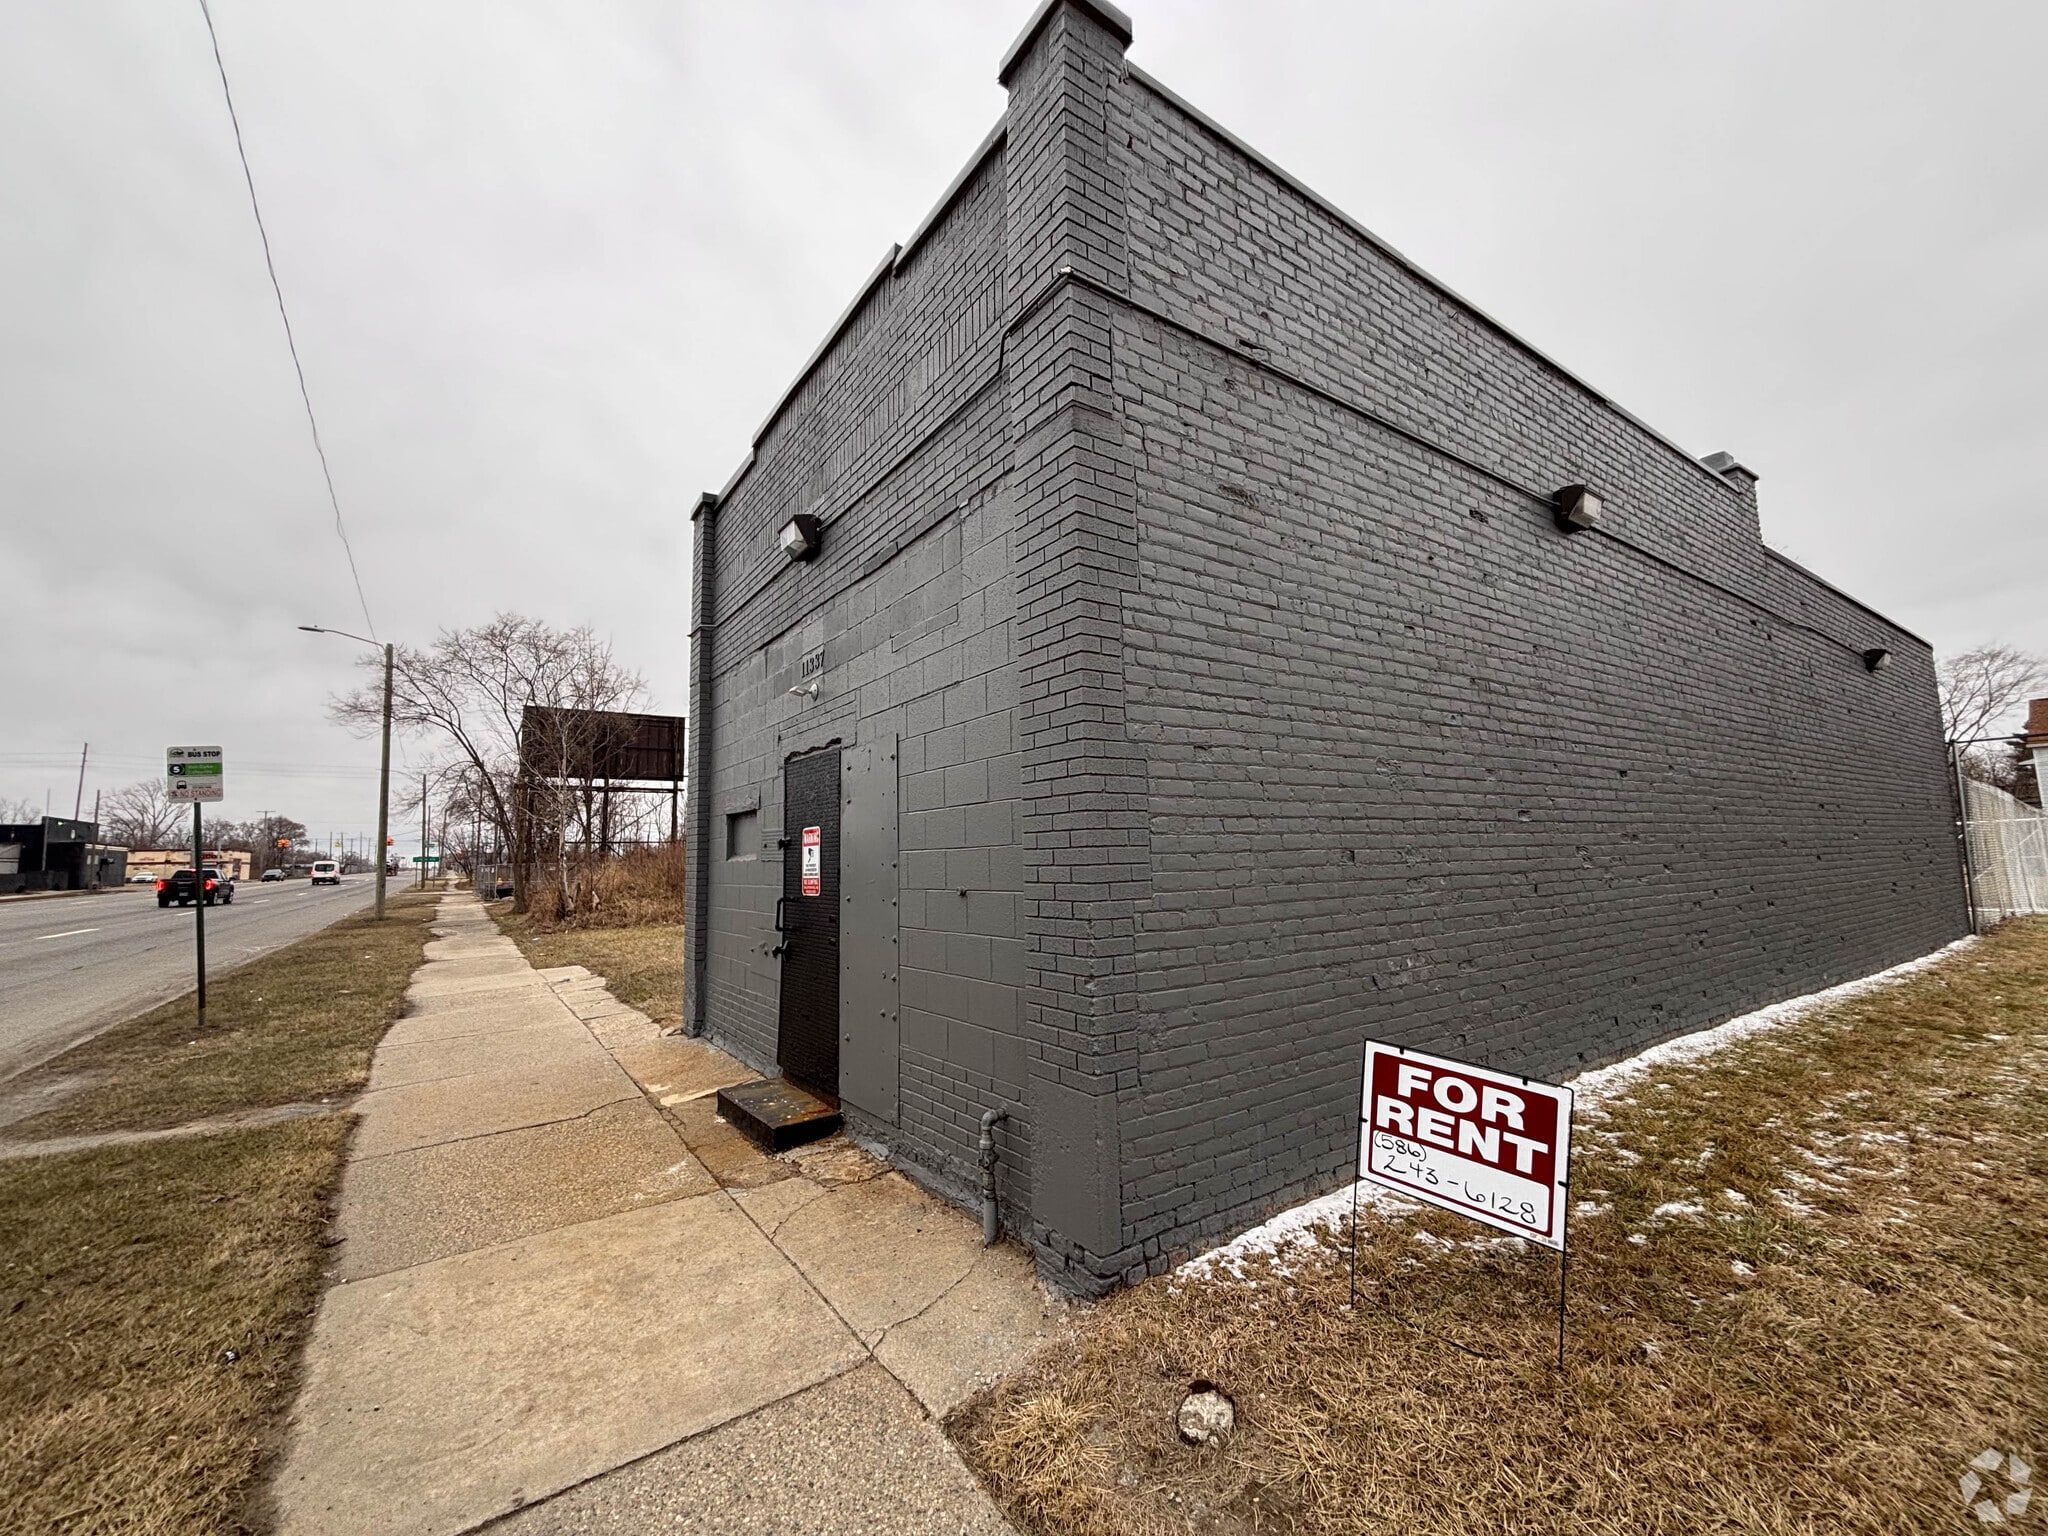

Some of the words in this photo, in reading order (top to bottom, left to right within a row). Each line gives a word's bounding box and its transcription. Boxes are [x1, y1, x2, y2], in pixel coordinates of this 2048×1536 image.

[802, 649, 825, 679] 11337
[1397, 1063, 1526, 1131] FOR
[1373, 1131, 1427, 1162] (586)
[1376, 1094, 1549, 1175] RENT
